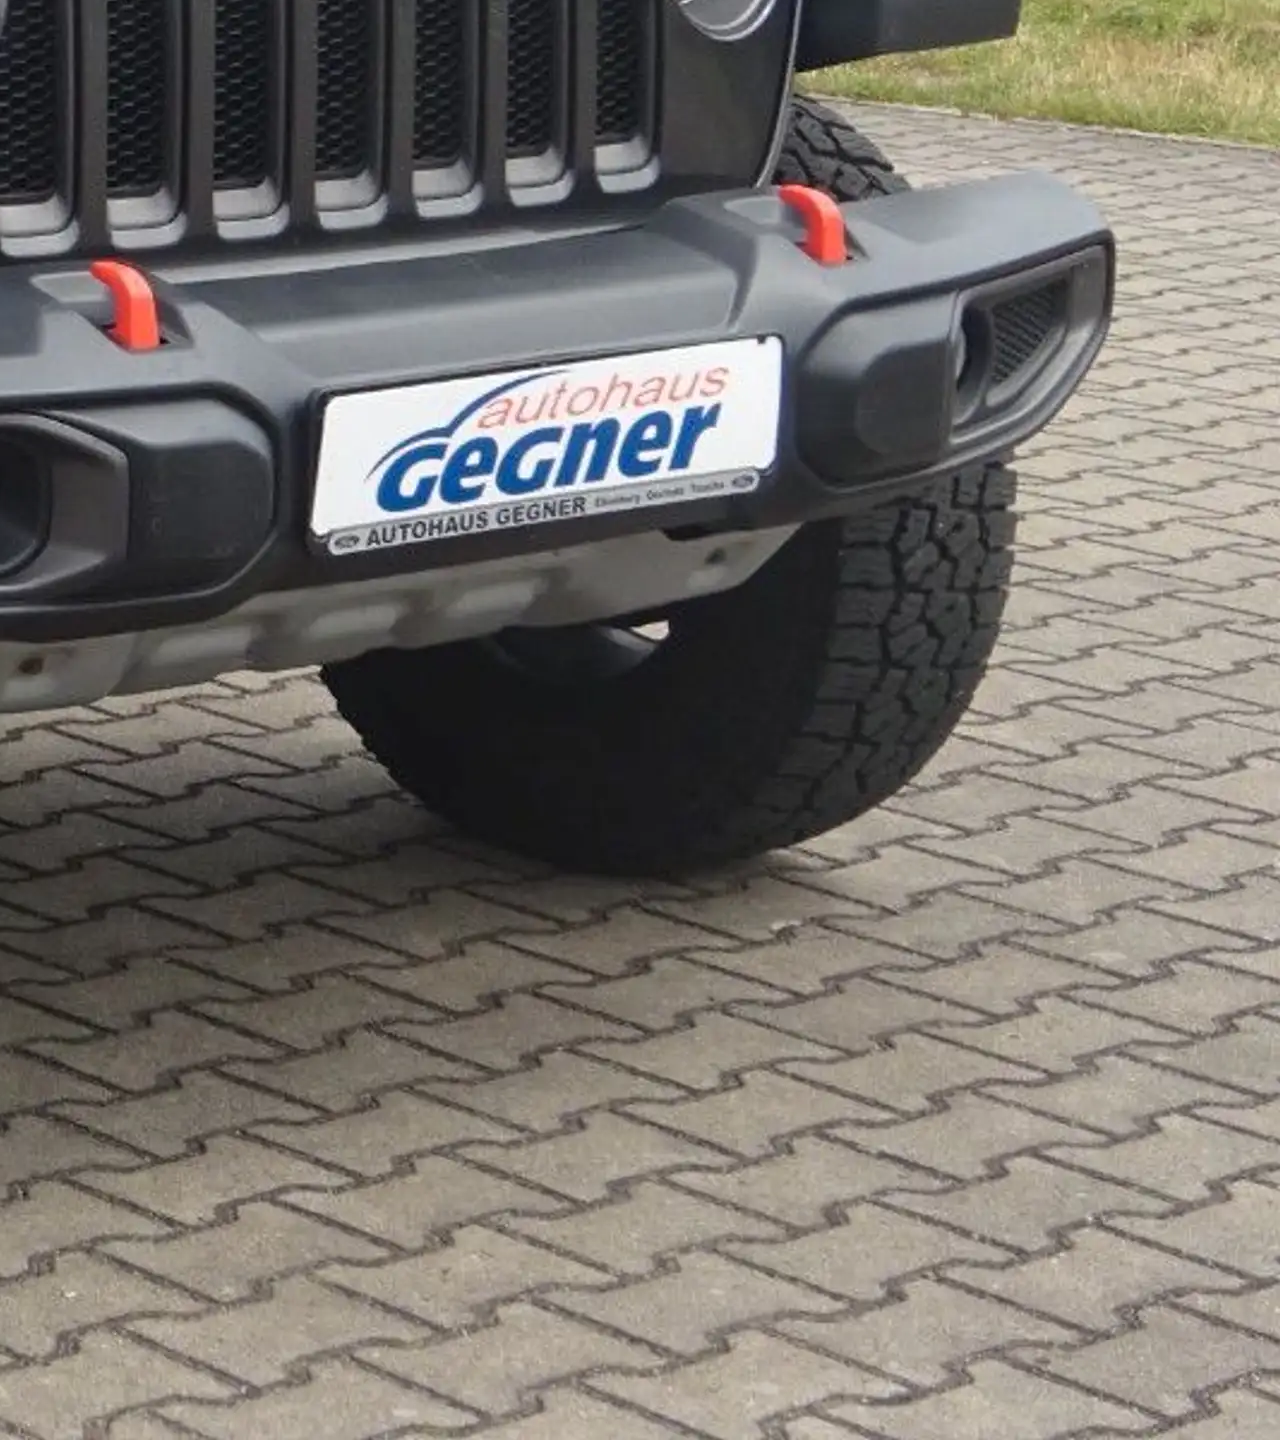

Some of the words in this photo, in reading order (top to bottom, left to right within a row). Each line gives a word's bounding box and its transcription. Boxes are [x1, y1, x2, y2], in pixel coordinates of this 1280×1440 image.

[477, 366, 729, 430] autohaus
[366, 510, 489, 547] AUTOHAUS
[495, 496, 587, 525] GEGNER
